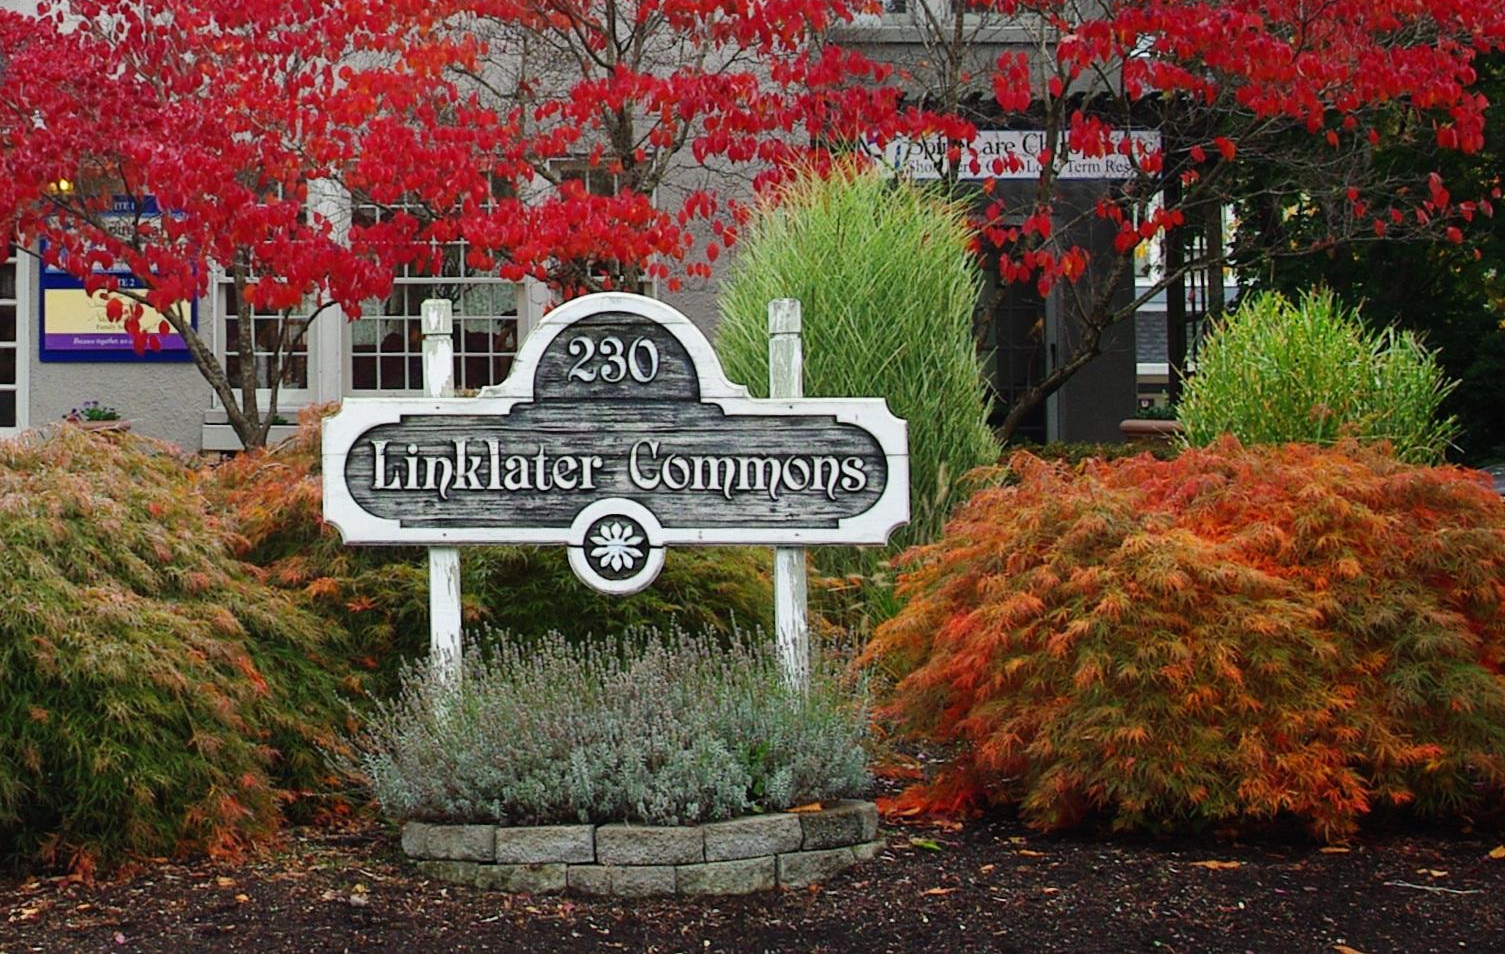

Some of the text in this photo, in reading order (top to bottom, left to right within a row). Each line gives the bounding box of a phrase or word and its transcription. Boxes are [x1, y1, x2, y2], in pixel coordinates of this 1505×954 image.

[1067, 159, 1100, 173] Term
[567, 336, 659, 384] 230
[370, 438, 868, 501] Linklater Commons
